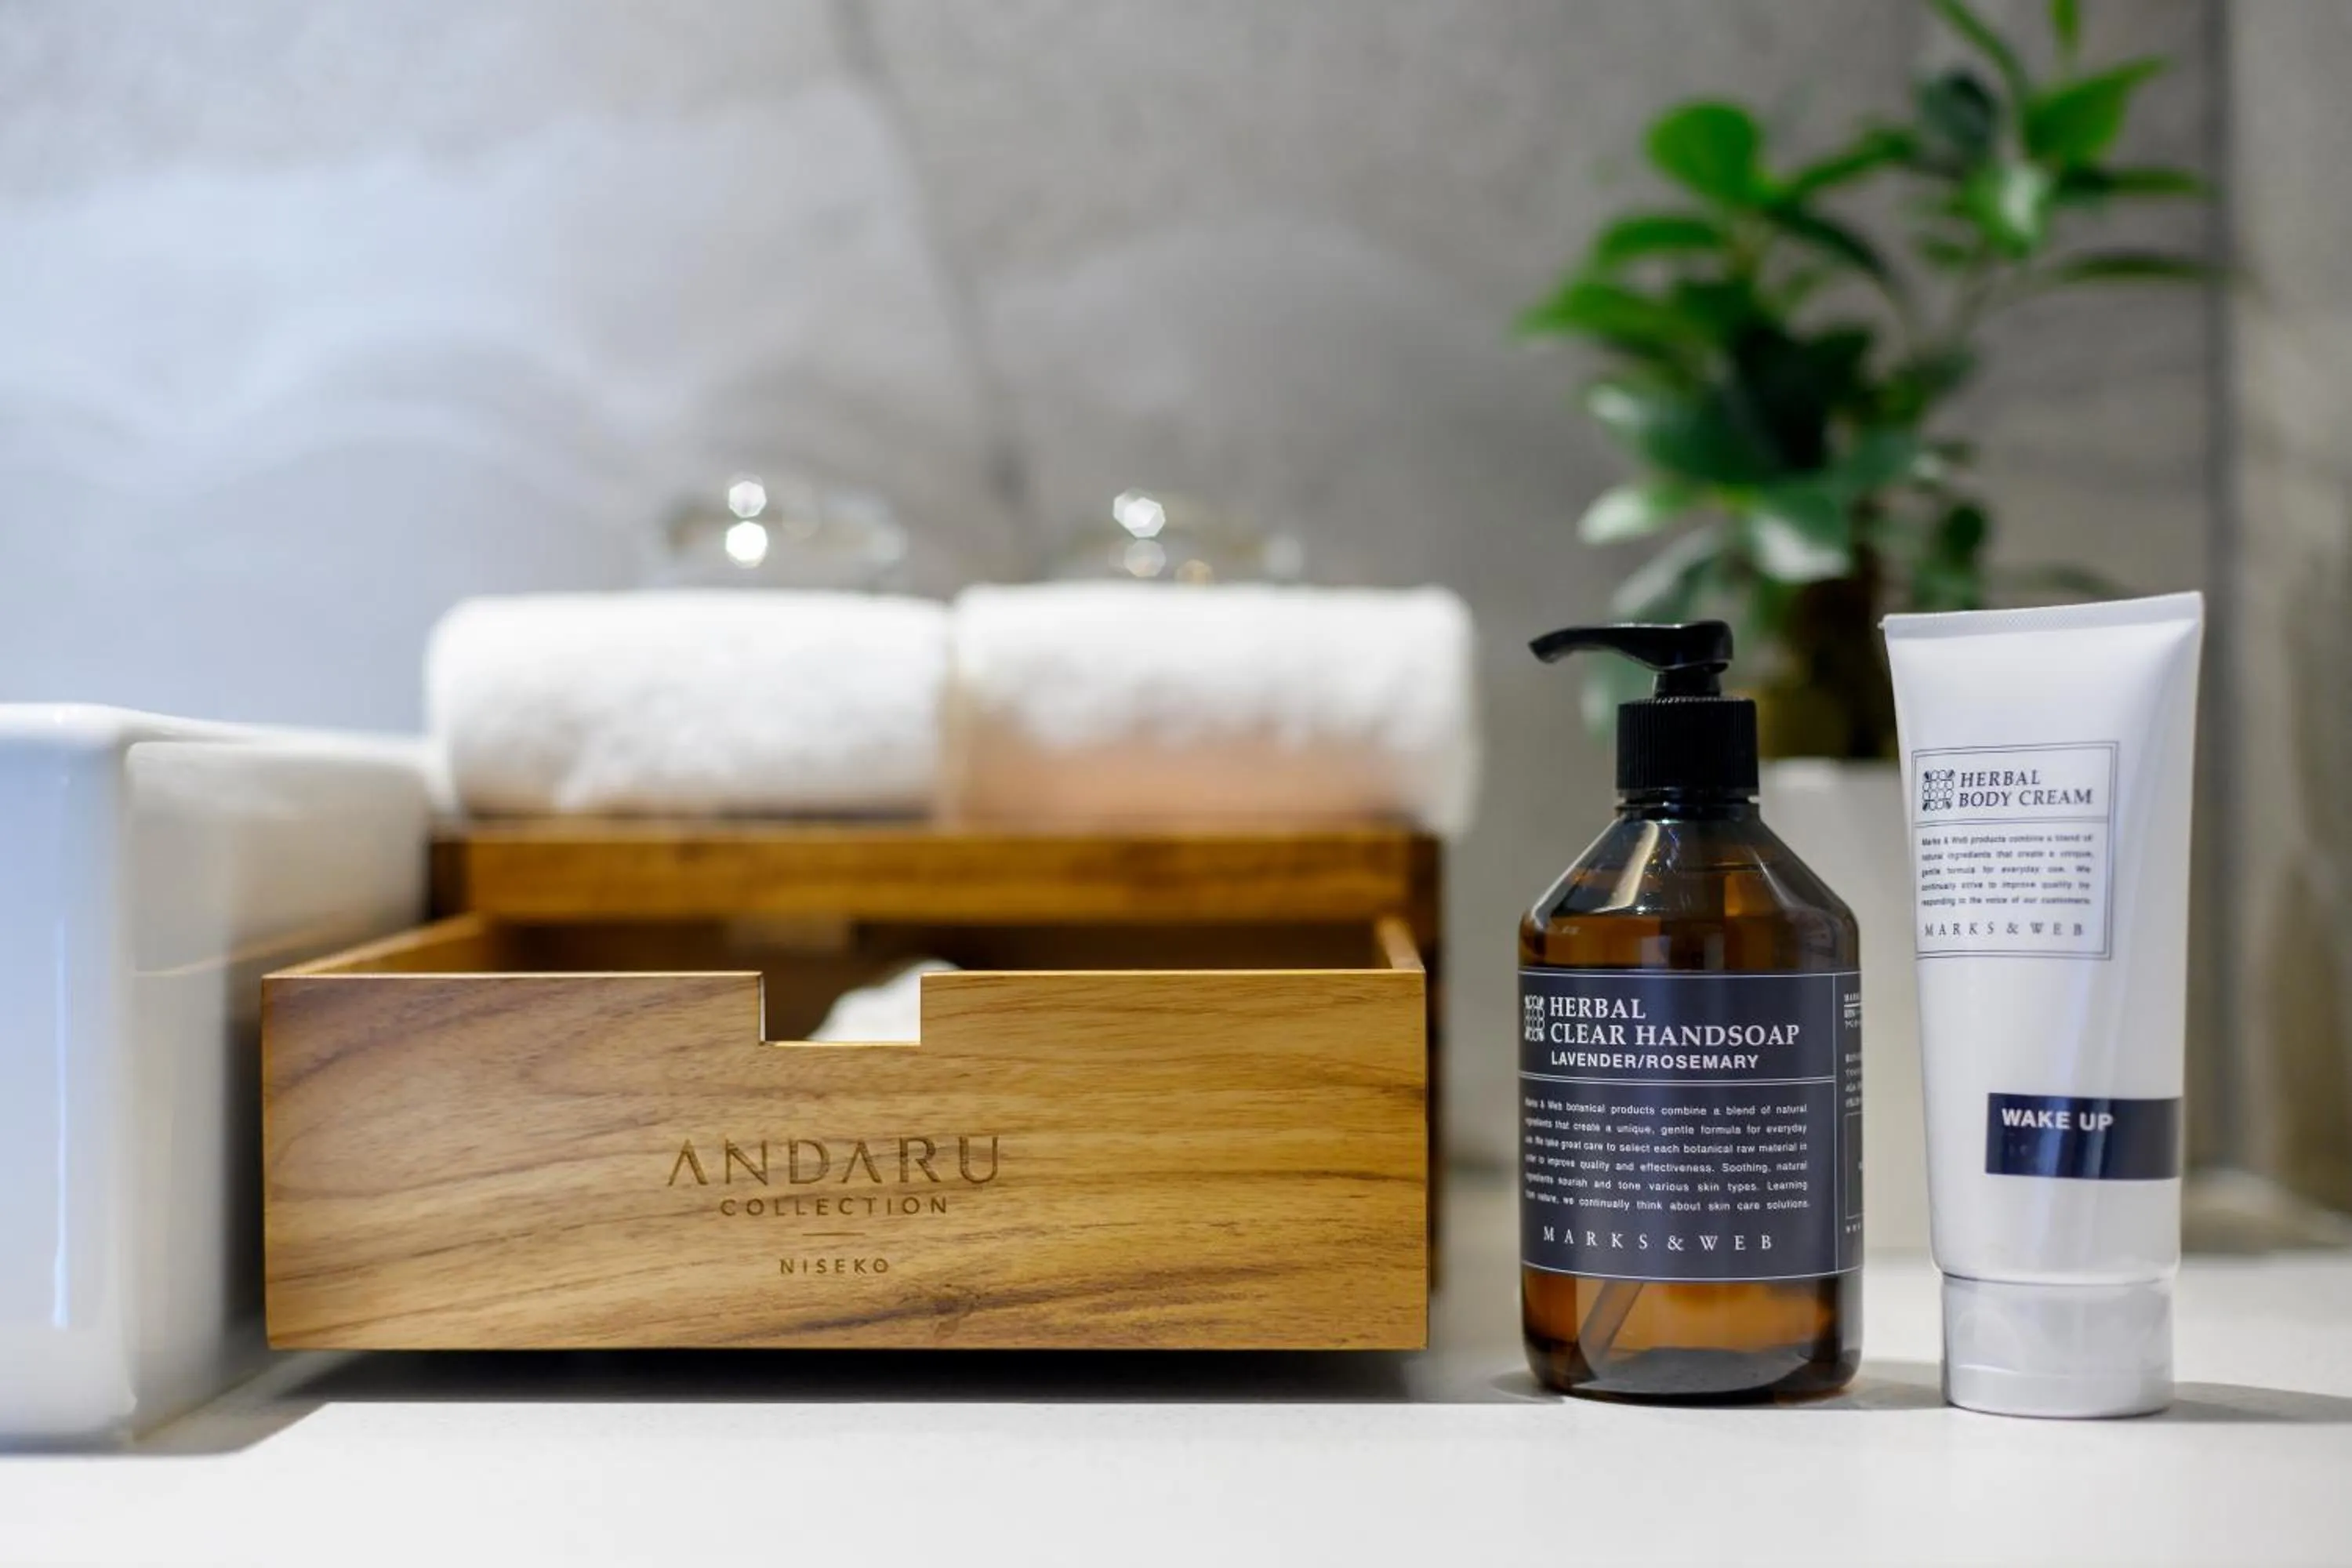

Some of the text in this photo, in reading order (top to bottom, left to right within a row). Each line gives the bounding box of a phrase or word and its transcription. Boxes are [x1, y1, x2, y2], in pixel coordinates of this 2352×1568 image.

[1960, 769, 2041, 787] HERBAL
[1959, 788, 2094, 808] BODY CREAM
[1970, 836, 2005, 845] products
[1924, 921, 2083, 938] MARKS & WEB
[1550, 996, 1646, 1019] HERBAL
[1550, 1022, 1800, 1047] CLEAR HANDSOAP
[1552, 1051, 1759, 1069] LAVENDER/ROSEMARY
[1566, 1102, 1605, 1113] botanical
[1611, 1105, 1655, 1116] products
[1661, 1105, 1707, 1116] combine
[1726, 1105, 1755, 1116] blend
[1761, 1105, 1770, 1115] of
[1776, 1104, 1807, 1114] natural
[2001, 1107, 2114, 1131] WAKE UP
[1573, 1123, 1600, 1132] create
[1661, 1125, 1694, 1136] gentle
[1700, 1125, 1741, 1134] formula
[1747, 1125, 1761, 1134] for
[1766, 1123, 1807, 1135] everyday
[1561, 1139, 1581, 1151] great
[1584, 1142, 1603, 1151] care
[1607, 1143, 1615, 1152] to
[1619, 1143, 1650, 1153] select
[1653, 1144, 1679, 1153] each
[1683, 1144, 1733, 1153] botanical
[1737, 1145, 1755, 1153] raw
[1759, 1142, 1797, 1152] material
[667, 1136, 1000, 1186] ANDARU
[1580, 1160, 1610, 1172] quality
[1615, 1161, 1634, 1171] and
[1639, 1162, 1715, 1173] effectiveness.
[1722, 1163, 1771, 1174] Soothing,
[1776, 1160, 1807, 1171] natural
[1594, 1179, 1611, 1189] and
[1617, 1181, 1641, 1190] tone
[1649, 1182, 1690, 1192] various
[1697, 1181, 1719, 1192] skin
[1766, 1180, 1808, 1192] Learning
[720, 1196, 948, 1217] COLLECTION
[1578, 1197, 1630, 1210] continually
[1636, 1200, 1663, 1210] think
[1669, 1201, 1701, 1211] about
[1708, 1201, 1730, 1211] skin
[1543, 1225, 1773, 1251] MARKS & WEB
[779, 1258, 890, 1274] NISEKO
